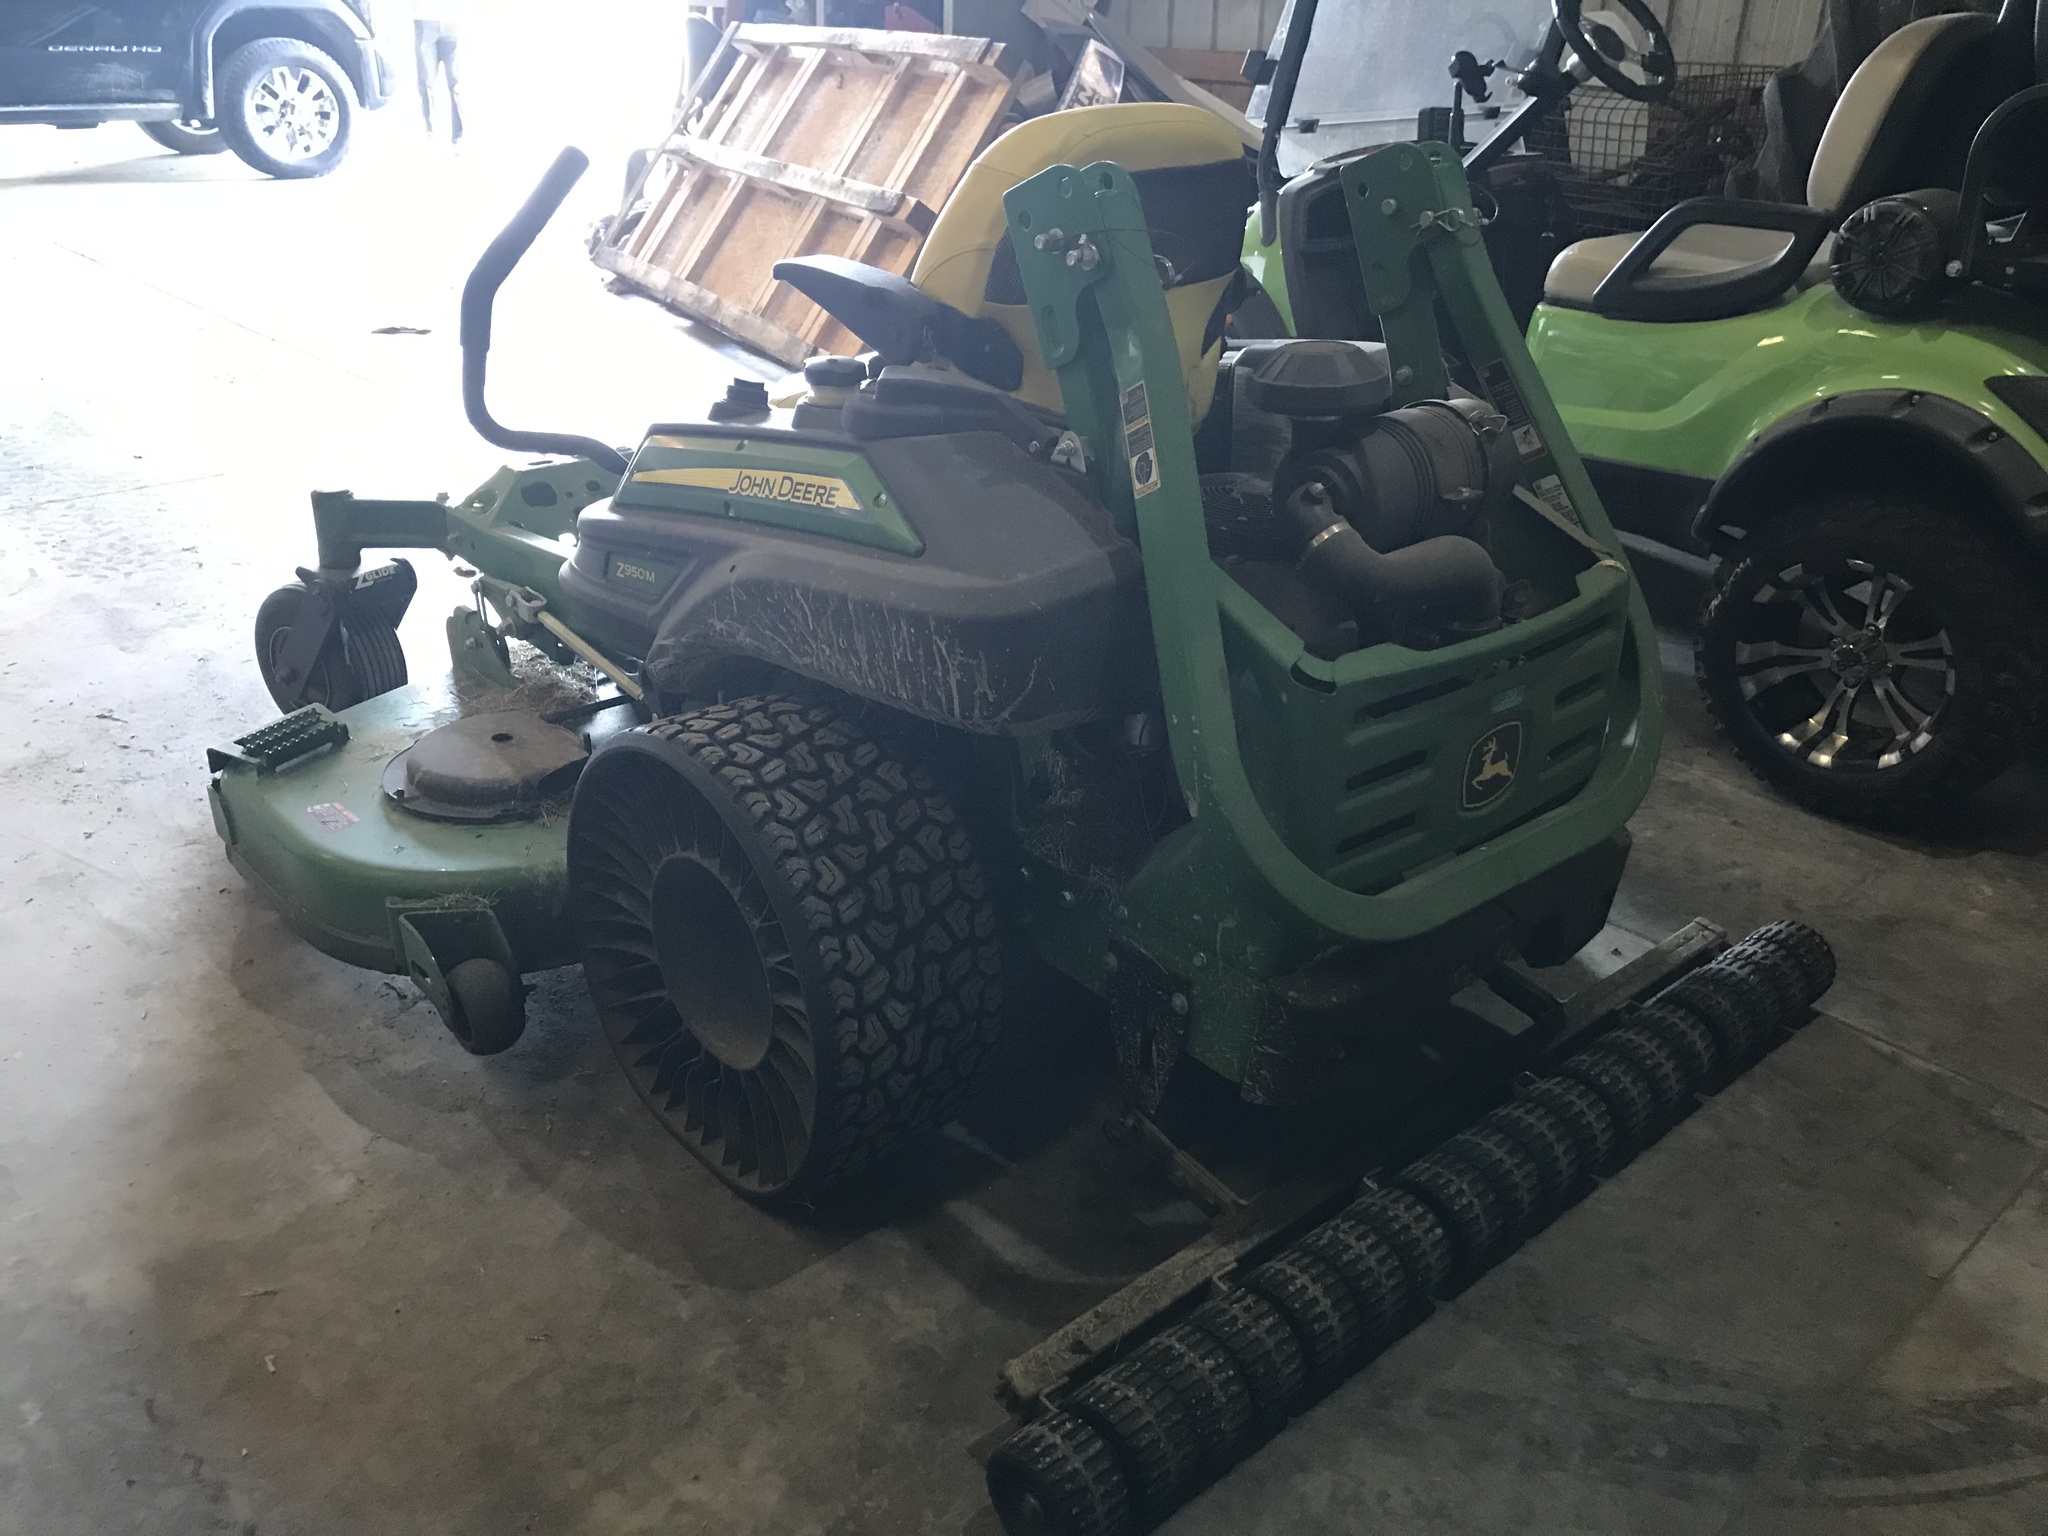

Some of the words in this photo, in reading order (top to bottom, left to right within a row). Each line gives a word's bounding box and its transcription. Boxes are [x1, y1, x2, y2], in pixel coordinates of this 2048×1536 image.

[131, 45, 162, 53] HD
[729, 470, 777, 497] JOHN
[777, 475, 841, 506] DEERE
[616, 562, 656, 583] Z950M
